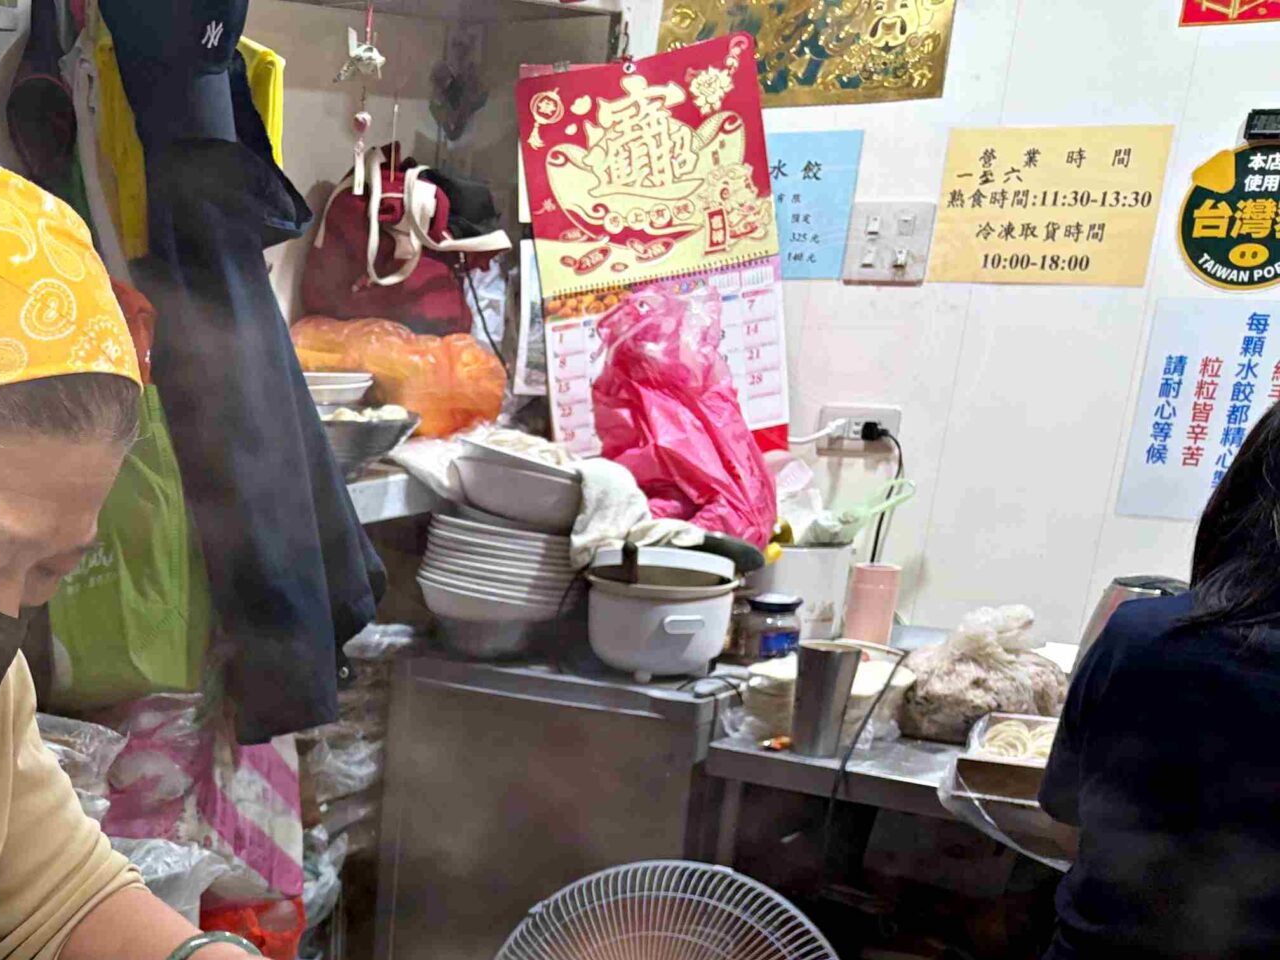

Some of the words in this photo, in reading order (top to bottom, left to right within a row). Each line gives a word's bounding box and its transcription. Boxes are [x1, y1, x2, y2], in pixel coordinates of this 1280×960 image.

[977, 147, 1132, 169] 營業時間
[770, 158, 823, 181] 水餃
[956, 166, 1024, 186] 一至六
[1243, 174, 1280, 193] 使用
[1191, 198, 1280, 239] 台灣
[975, 221, 1107, 243] 冷凍取貨時間
[980, 252, 1090, 272] 10:00-18:00
[1198, 253, 1250, 283] TAIWAN
[747, 299, 756, 311] 7
[747, 348, 760, 361] 21
[1145, 354, 1188, 465] 請耐心等候
[1181, 355, 1224, 468] 粒粒皆辛苦
